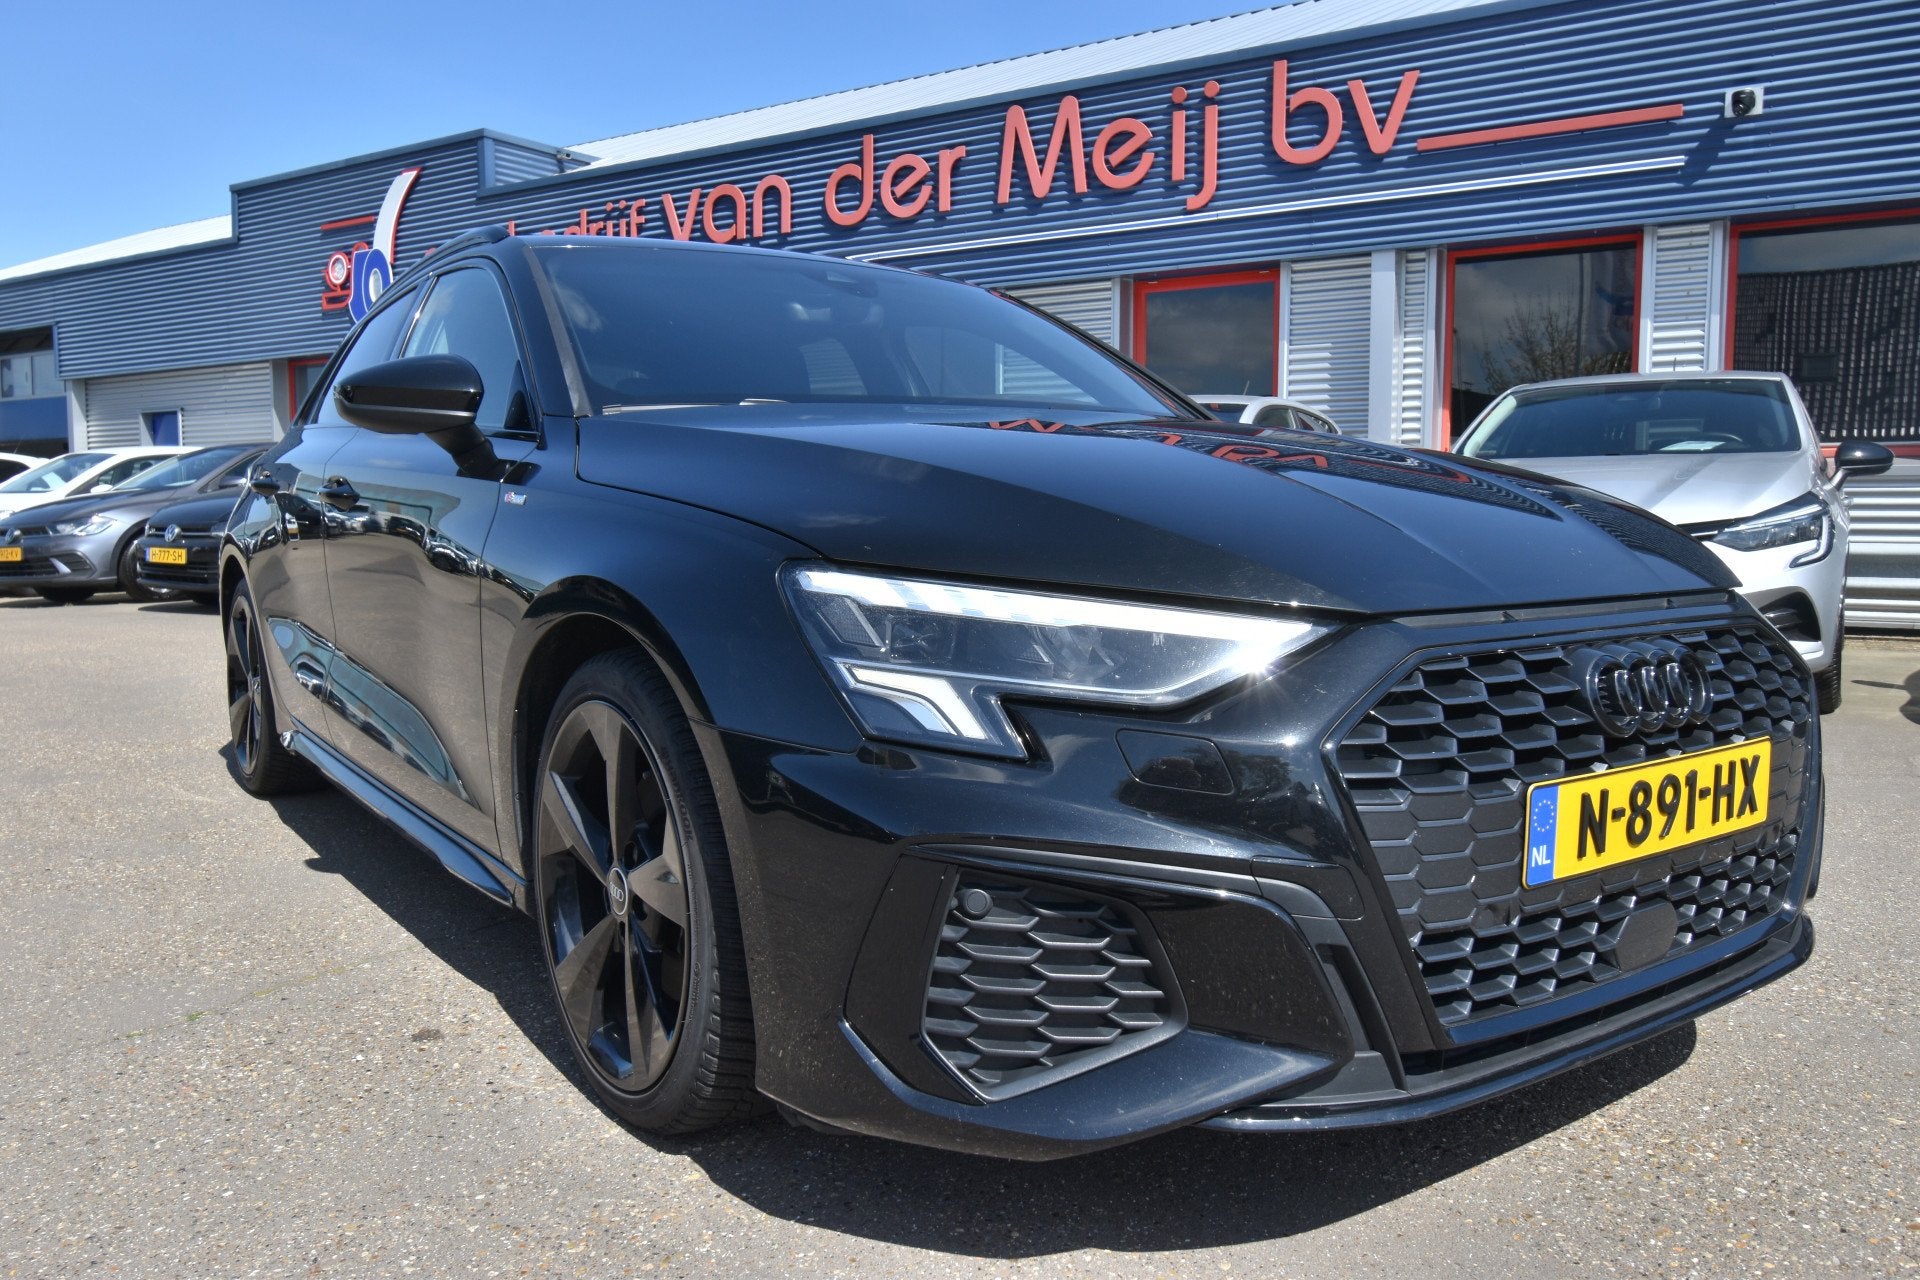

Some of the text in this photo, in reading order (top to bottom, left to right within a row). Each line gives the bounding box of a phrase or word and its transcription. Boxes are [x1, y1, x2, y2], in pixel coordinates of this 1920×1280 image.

[661, 174, 792, 243] van
[824, 133, 966, 226] der
[997, 80, 1220, 210] Meij
[1271, 59, 1420, 164] bv
[151, 549, 183, 562] H-777-SH
[1577, 754, 1761, 862] N-891-HX
[1531, 845, 1551, 868] NL
